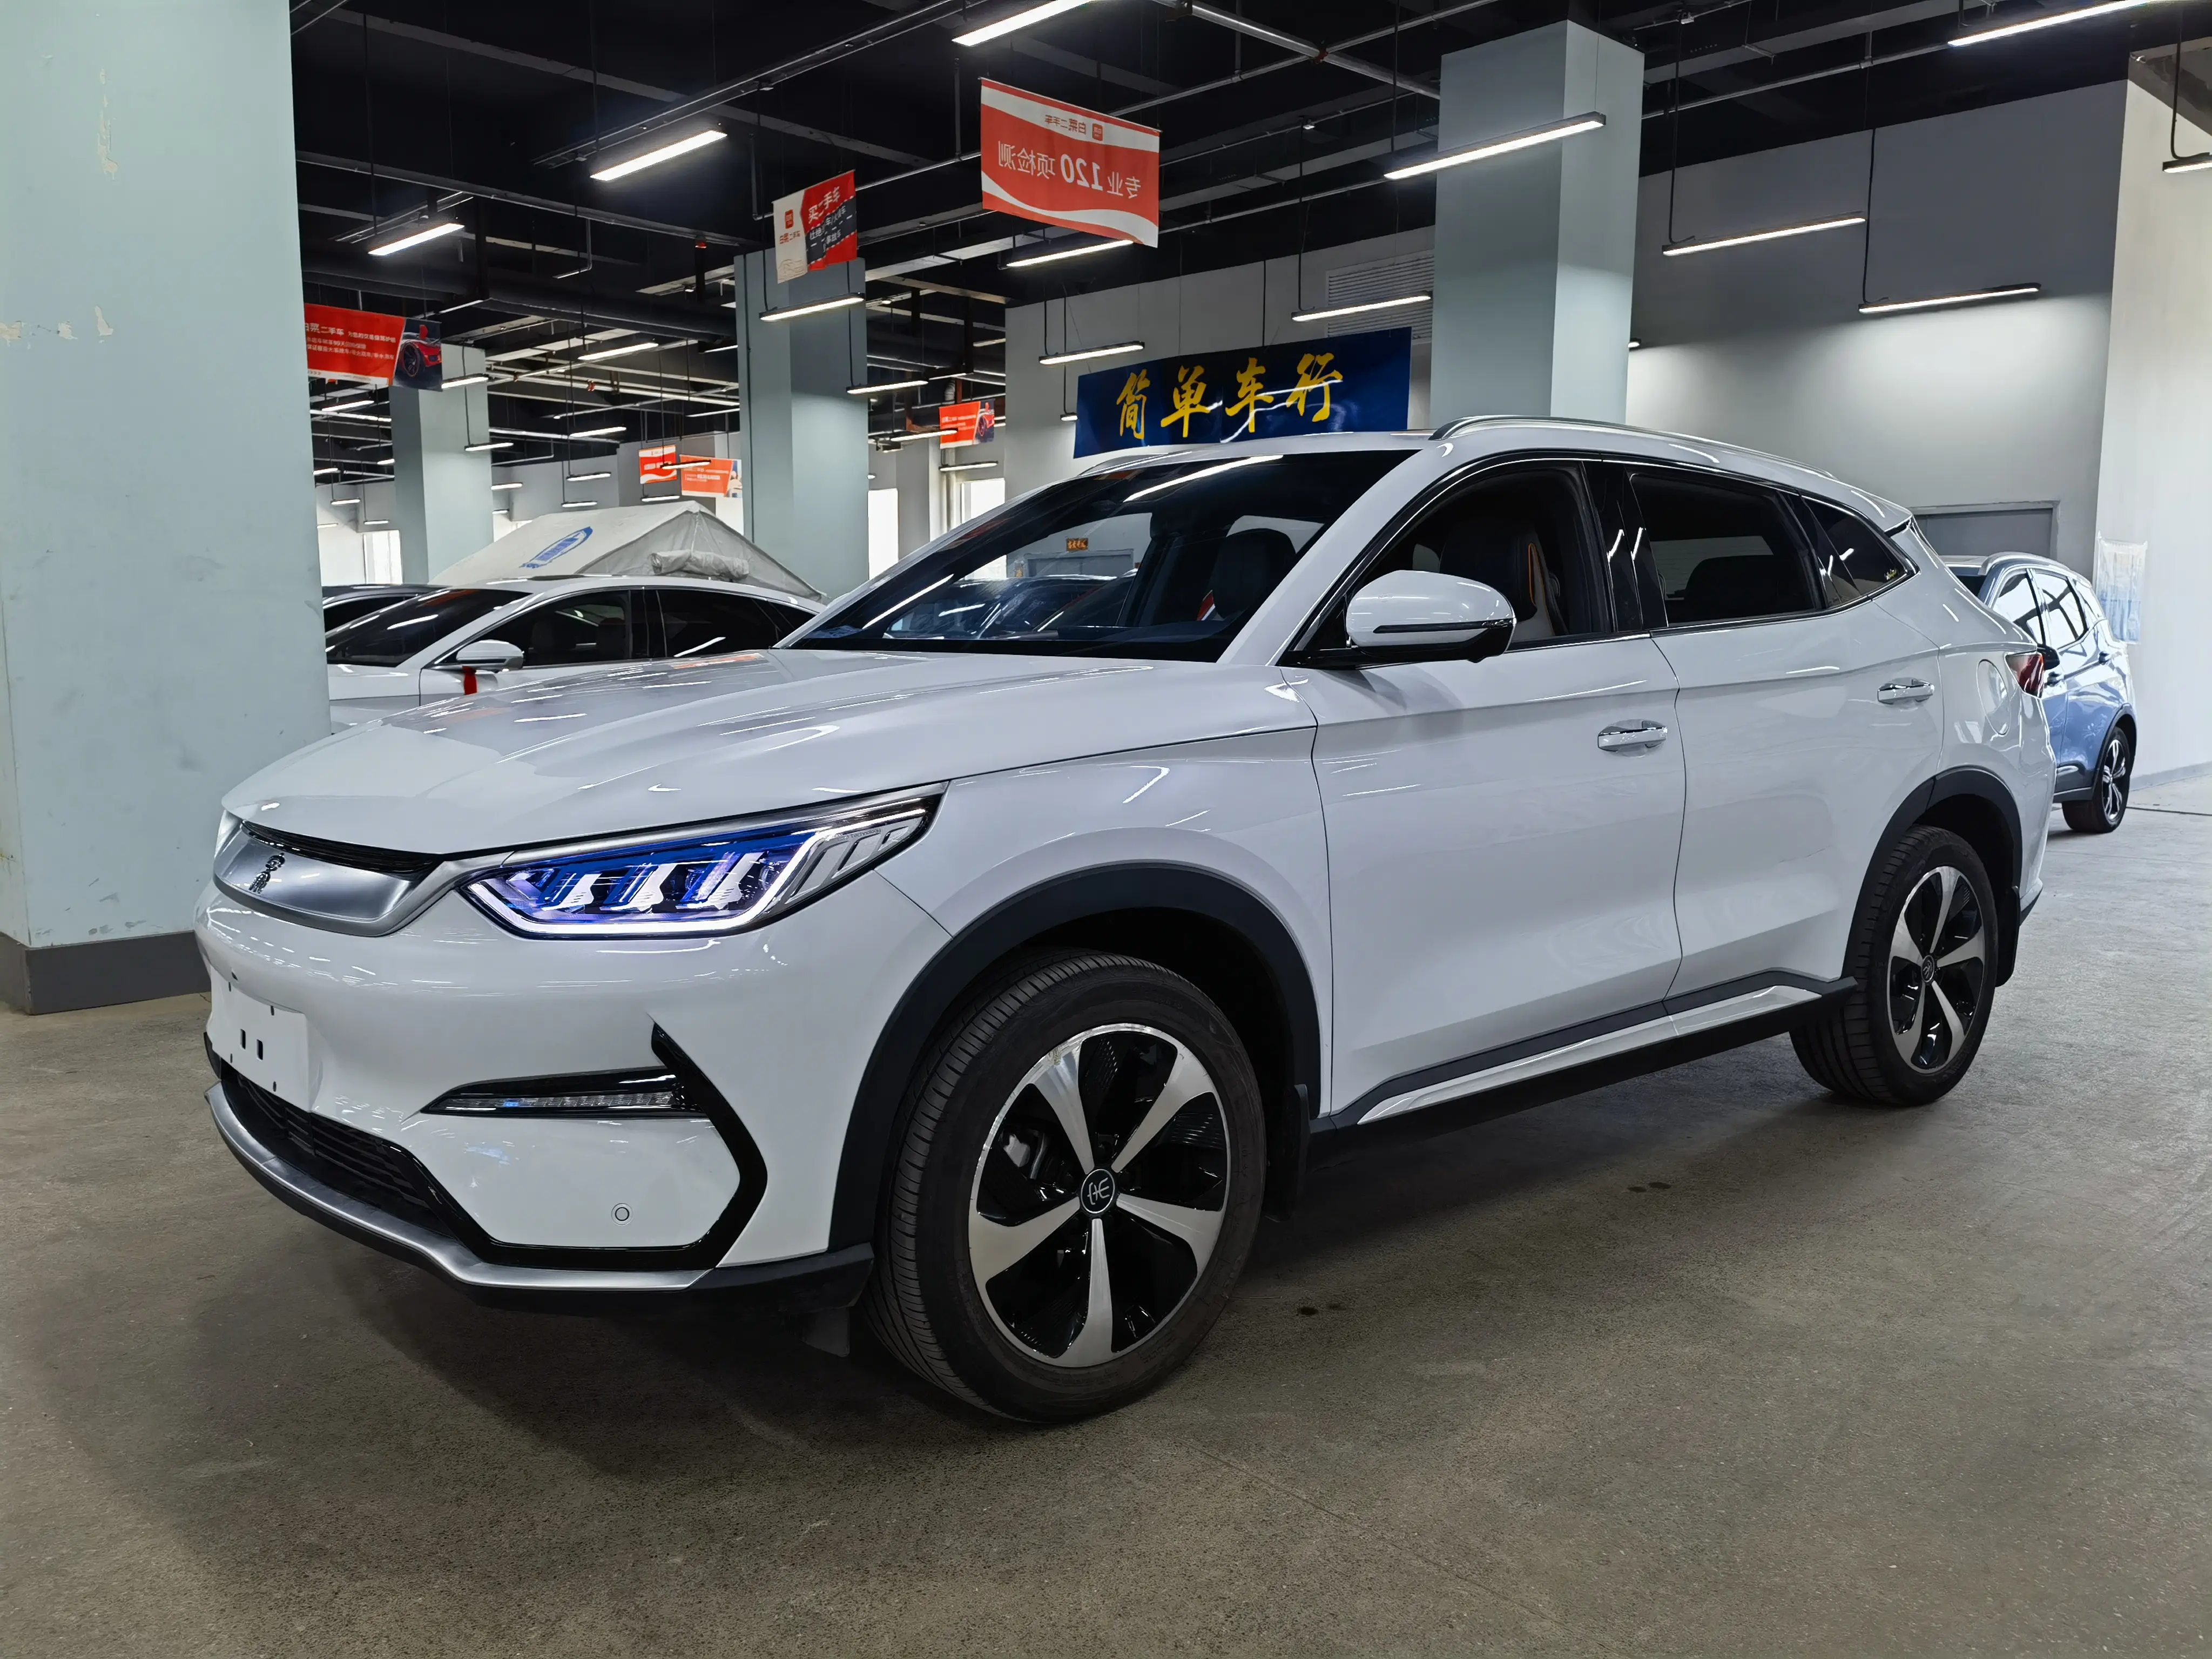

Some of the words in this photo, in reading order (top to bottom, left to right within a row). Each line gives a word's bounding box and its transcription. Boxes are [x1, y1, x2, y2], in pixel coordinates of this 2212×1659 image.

[808, 186, 840, 224] 买二手车
[1117, 352, 1343, 440] 简单车行
[851, 827, 882, 838] Technology
